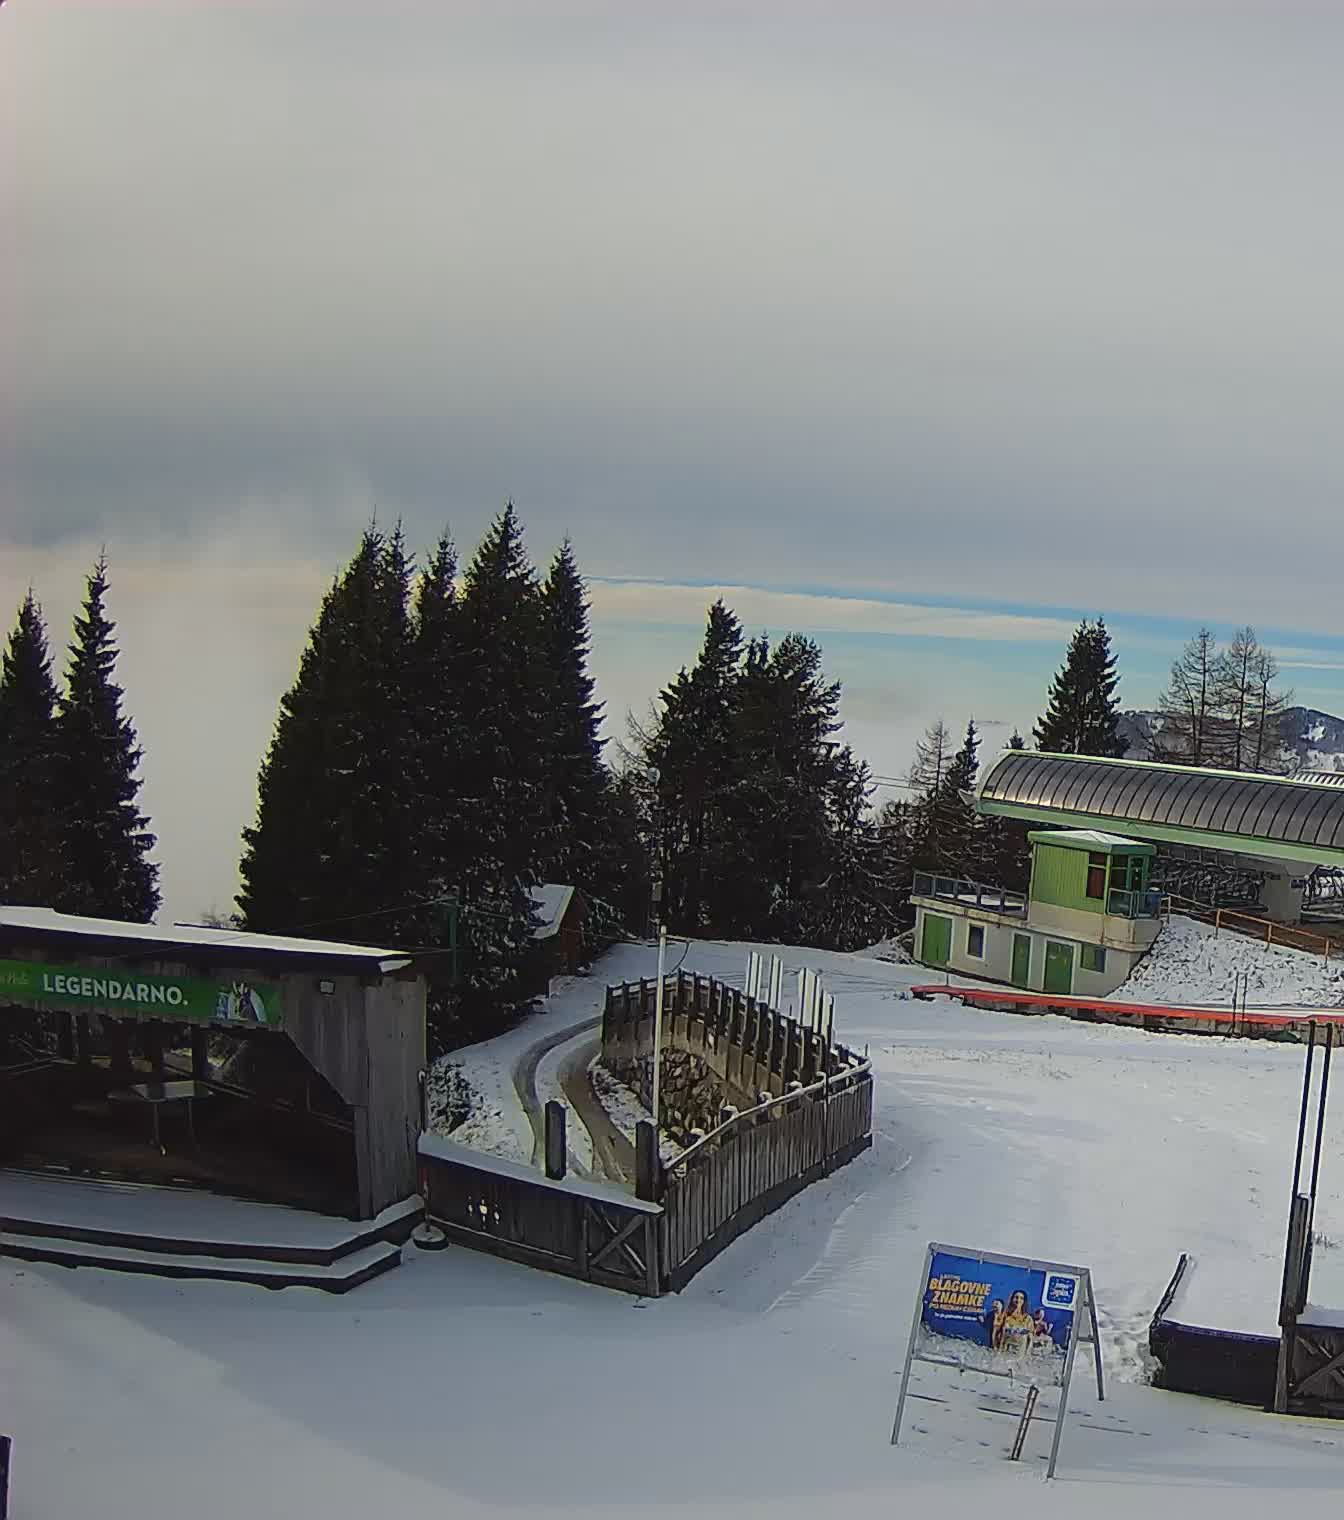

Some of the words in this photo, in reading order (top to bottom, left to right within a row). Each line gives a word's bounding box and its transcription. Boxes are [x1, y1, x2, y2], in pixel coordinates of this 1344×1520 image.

[42, 973, 189, 1006] LEGENDARNO.
[929, 1278, 992, 1296] BLAGOVNE
[932, 1290, 985, 1307] ZNAMKE
